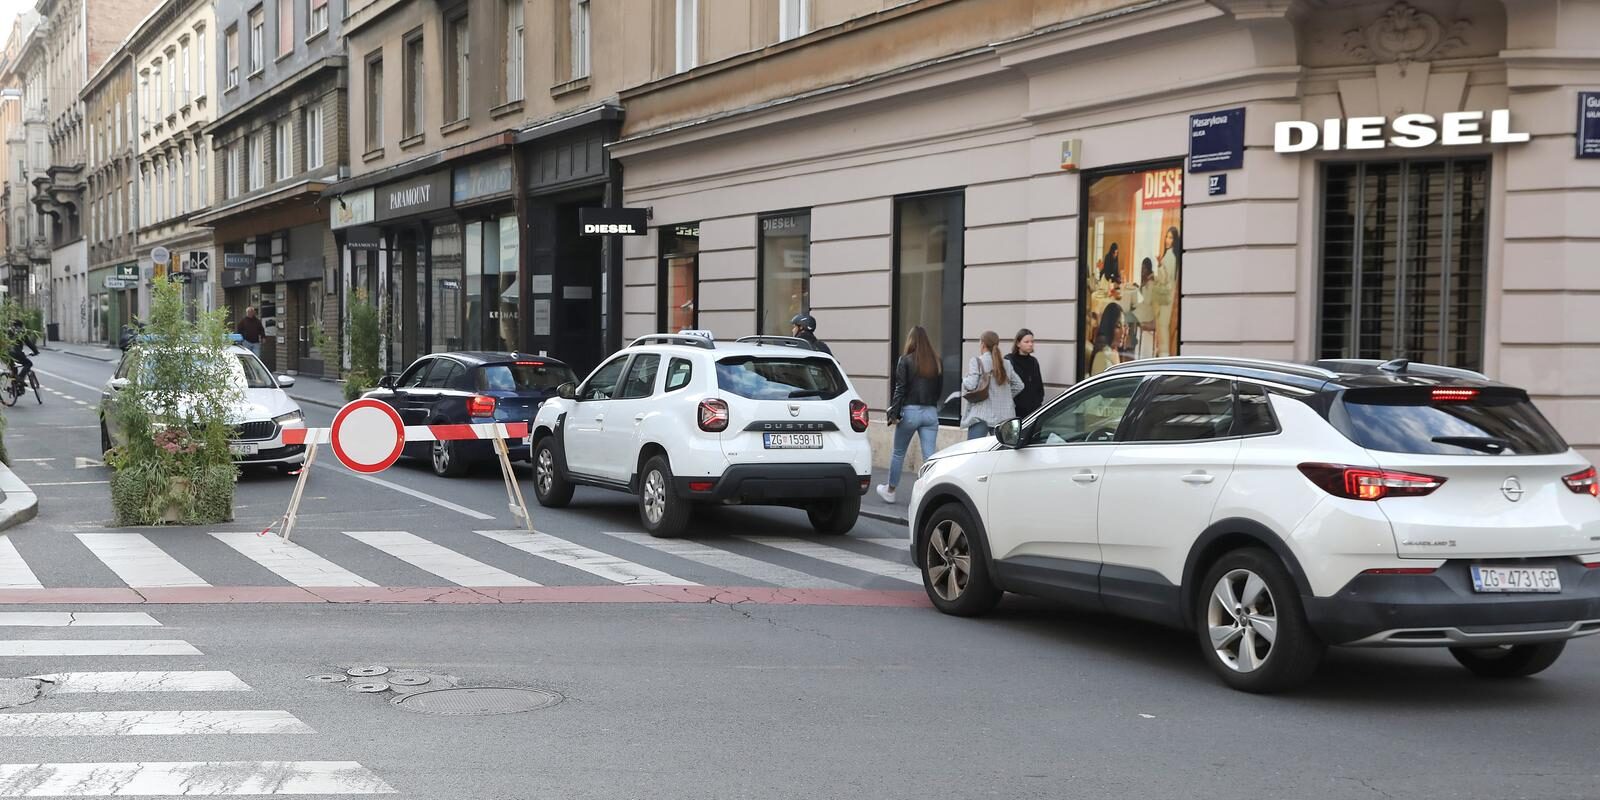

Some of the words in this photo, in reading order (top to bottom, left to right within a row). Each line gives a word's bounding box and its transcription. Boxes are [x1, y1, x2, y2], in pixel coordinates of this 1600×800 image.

[1193, 115, 1228, 128] Masarykova
[1274, 109, 1530, 153] DIESEL
[1210, 177, 1219, 187] 17
[390, 184, 431, 210] PARAMOUNT
[584, 224, 636, 234] DIESEL
[763, 216, 796, 230] DIESEL
[770, 434, 783, 445] ZG
[1481, 569, 1499, 587] ZG
